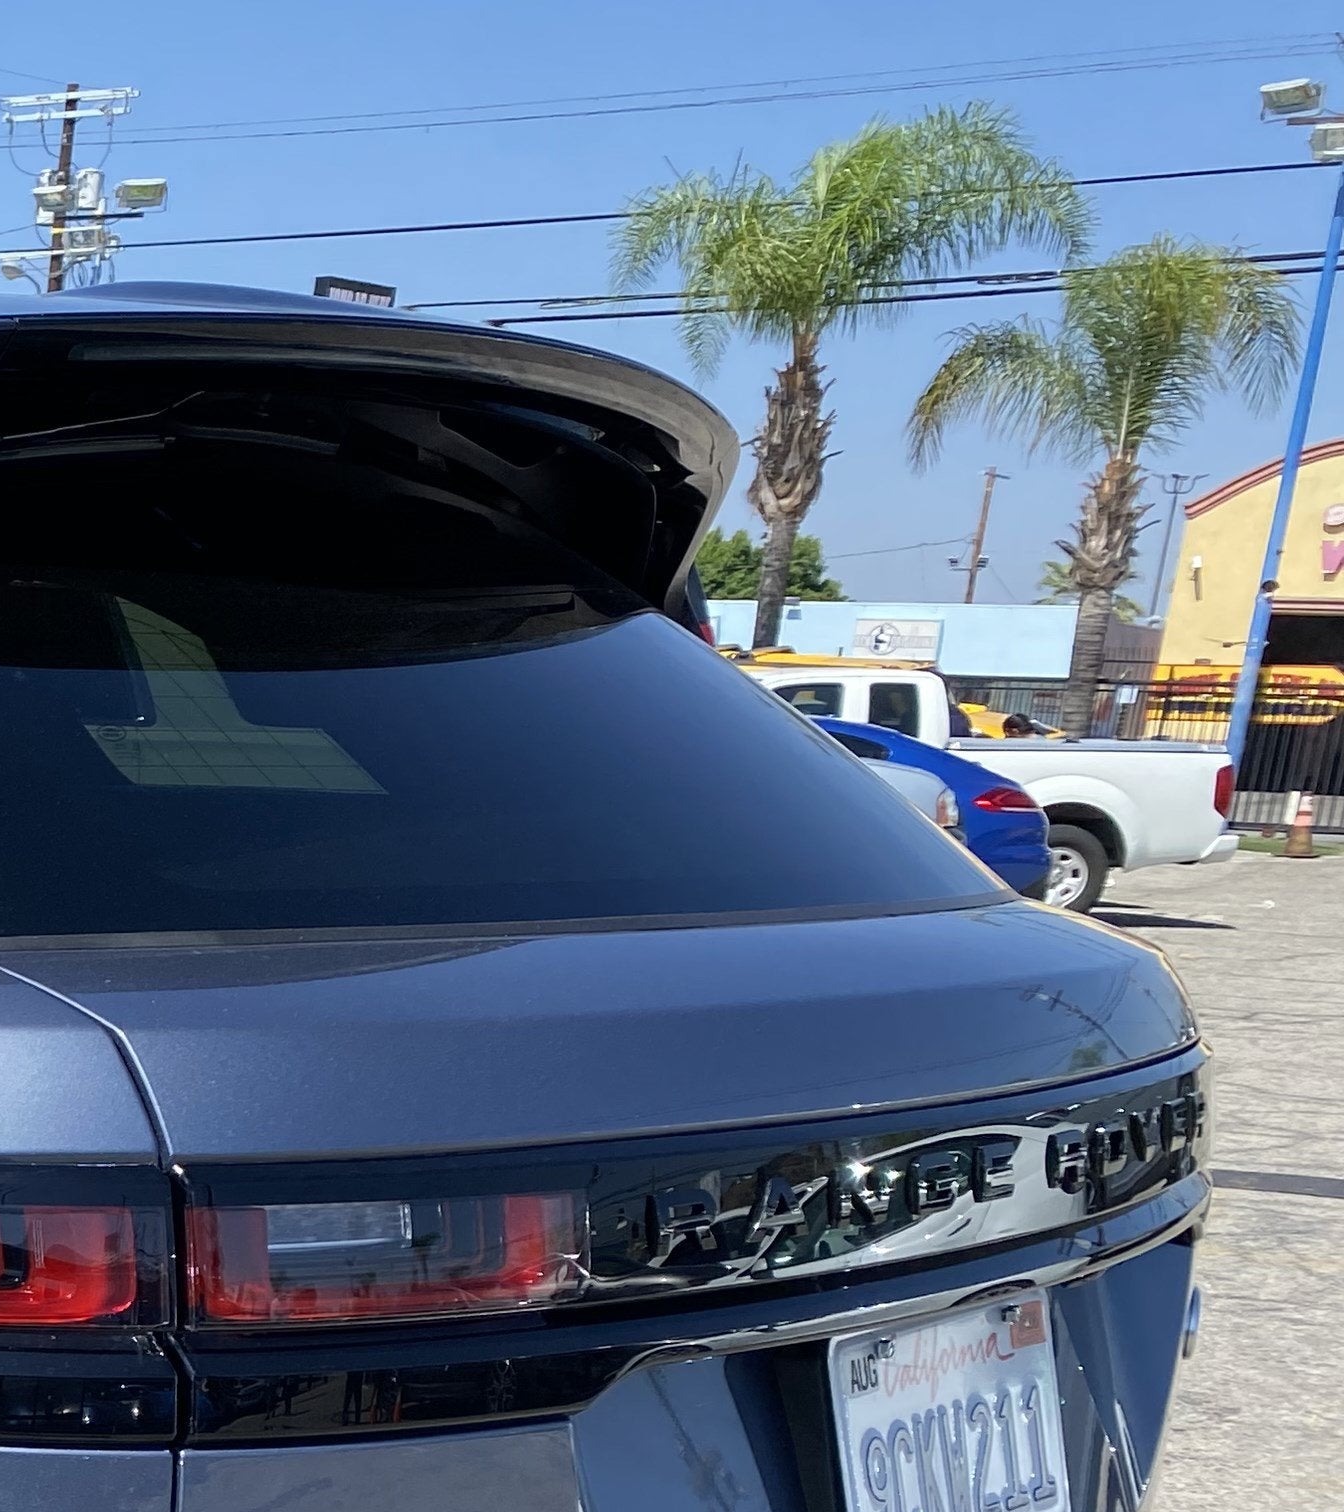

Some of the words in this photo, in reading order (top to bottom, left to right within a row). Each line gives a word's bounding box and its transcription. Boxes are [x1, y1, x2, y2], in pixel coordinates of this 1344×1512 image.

[644, 1141, 1017, 1260] RANGE
[850, 1353, 879, 1394] AUG
[883, 1325, 1016, 1402] California
